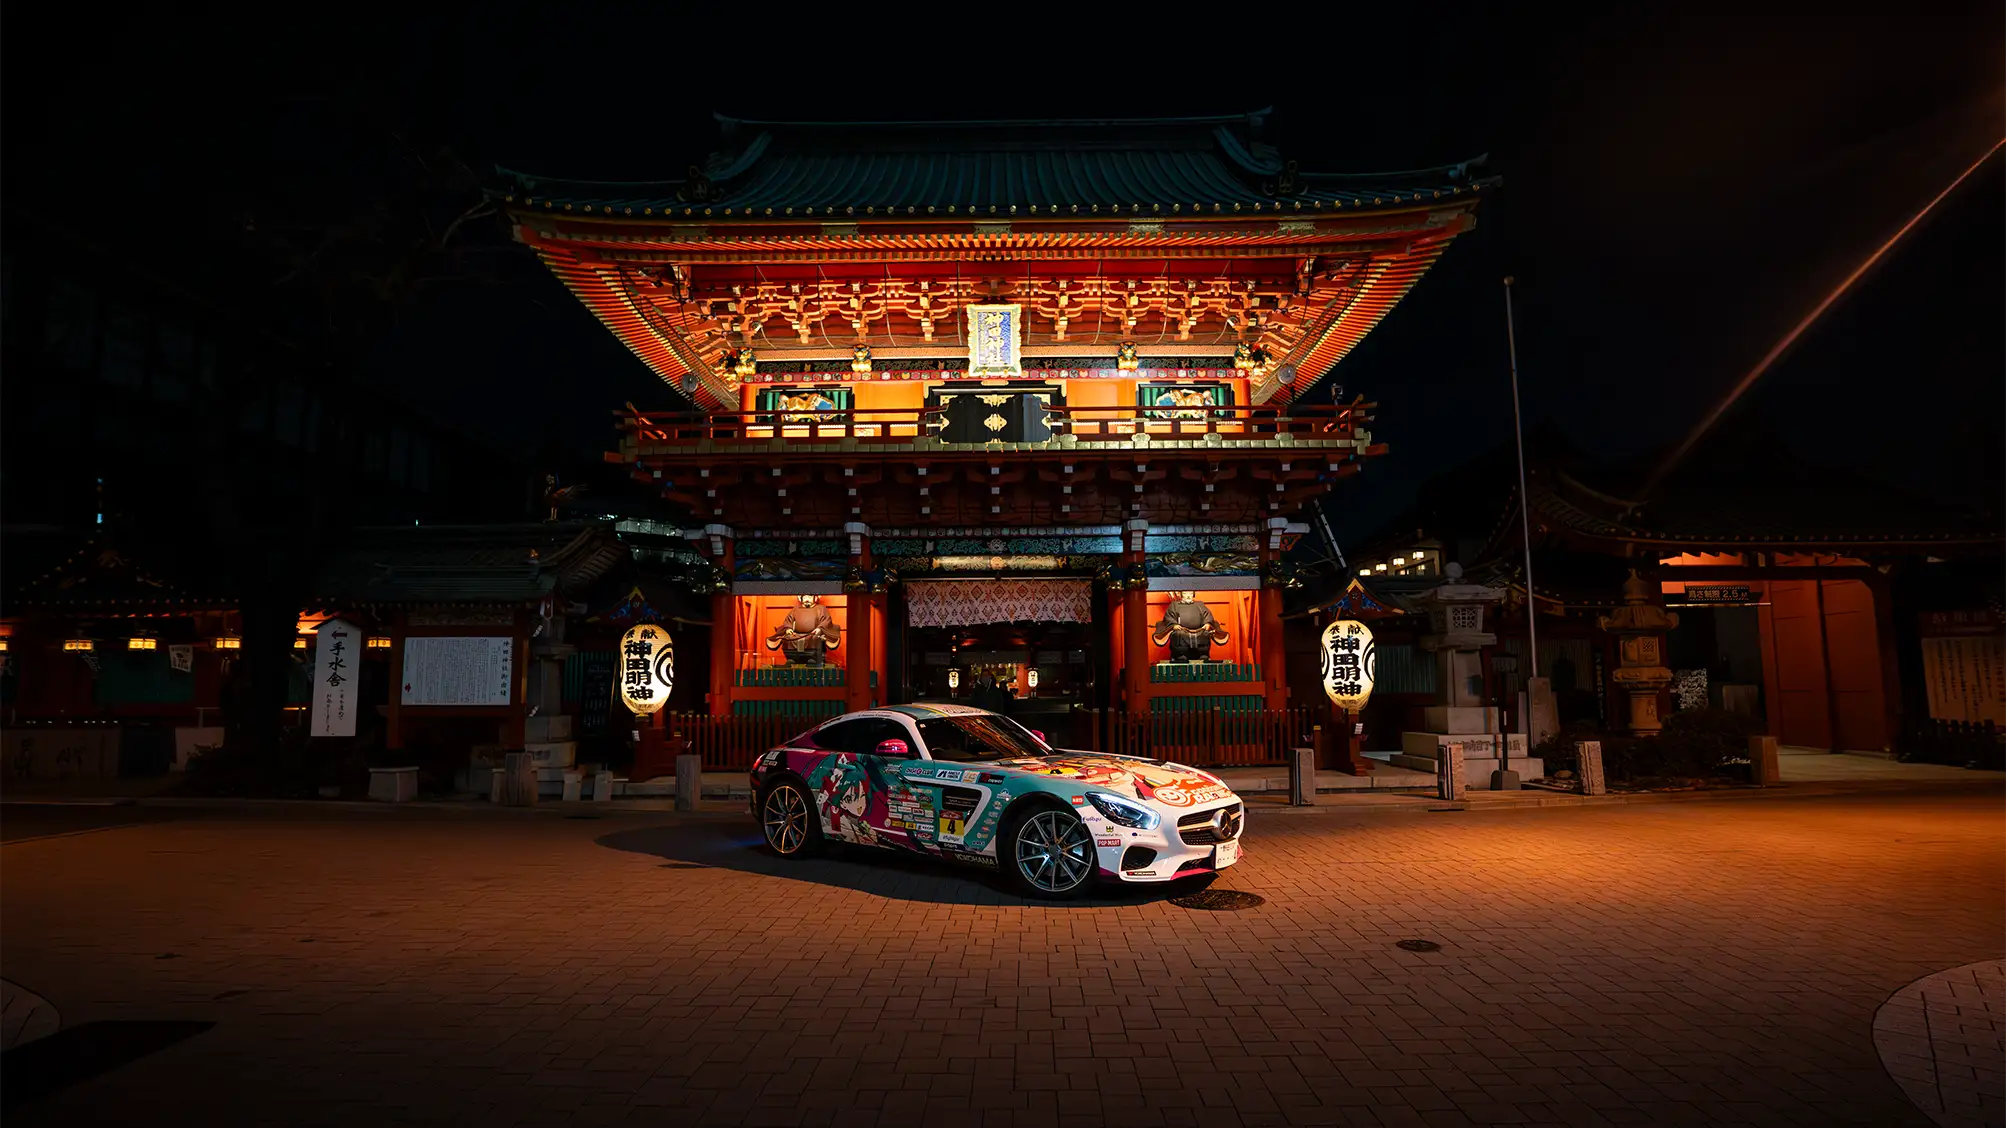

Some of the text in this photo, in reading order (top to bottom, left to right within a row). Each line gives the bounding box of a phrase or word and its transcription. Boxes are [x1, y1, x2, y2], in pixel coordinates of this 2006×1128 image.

[326, 641, 347, 687] 手水舎
[624, 640, 654, 700] 神田明神
[1330, 634, 1362, 697] 神田明神
[947, 820, 956, 834] 4
